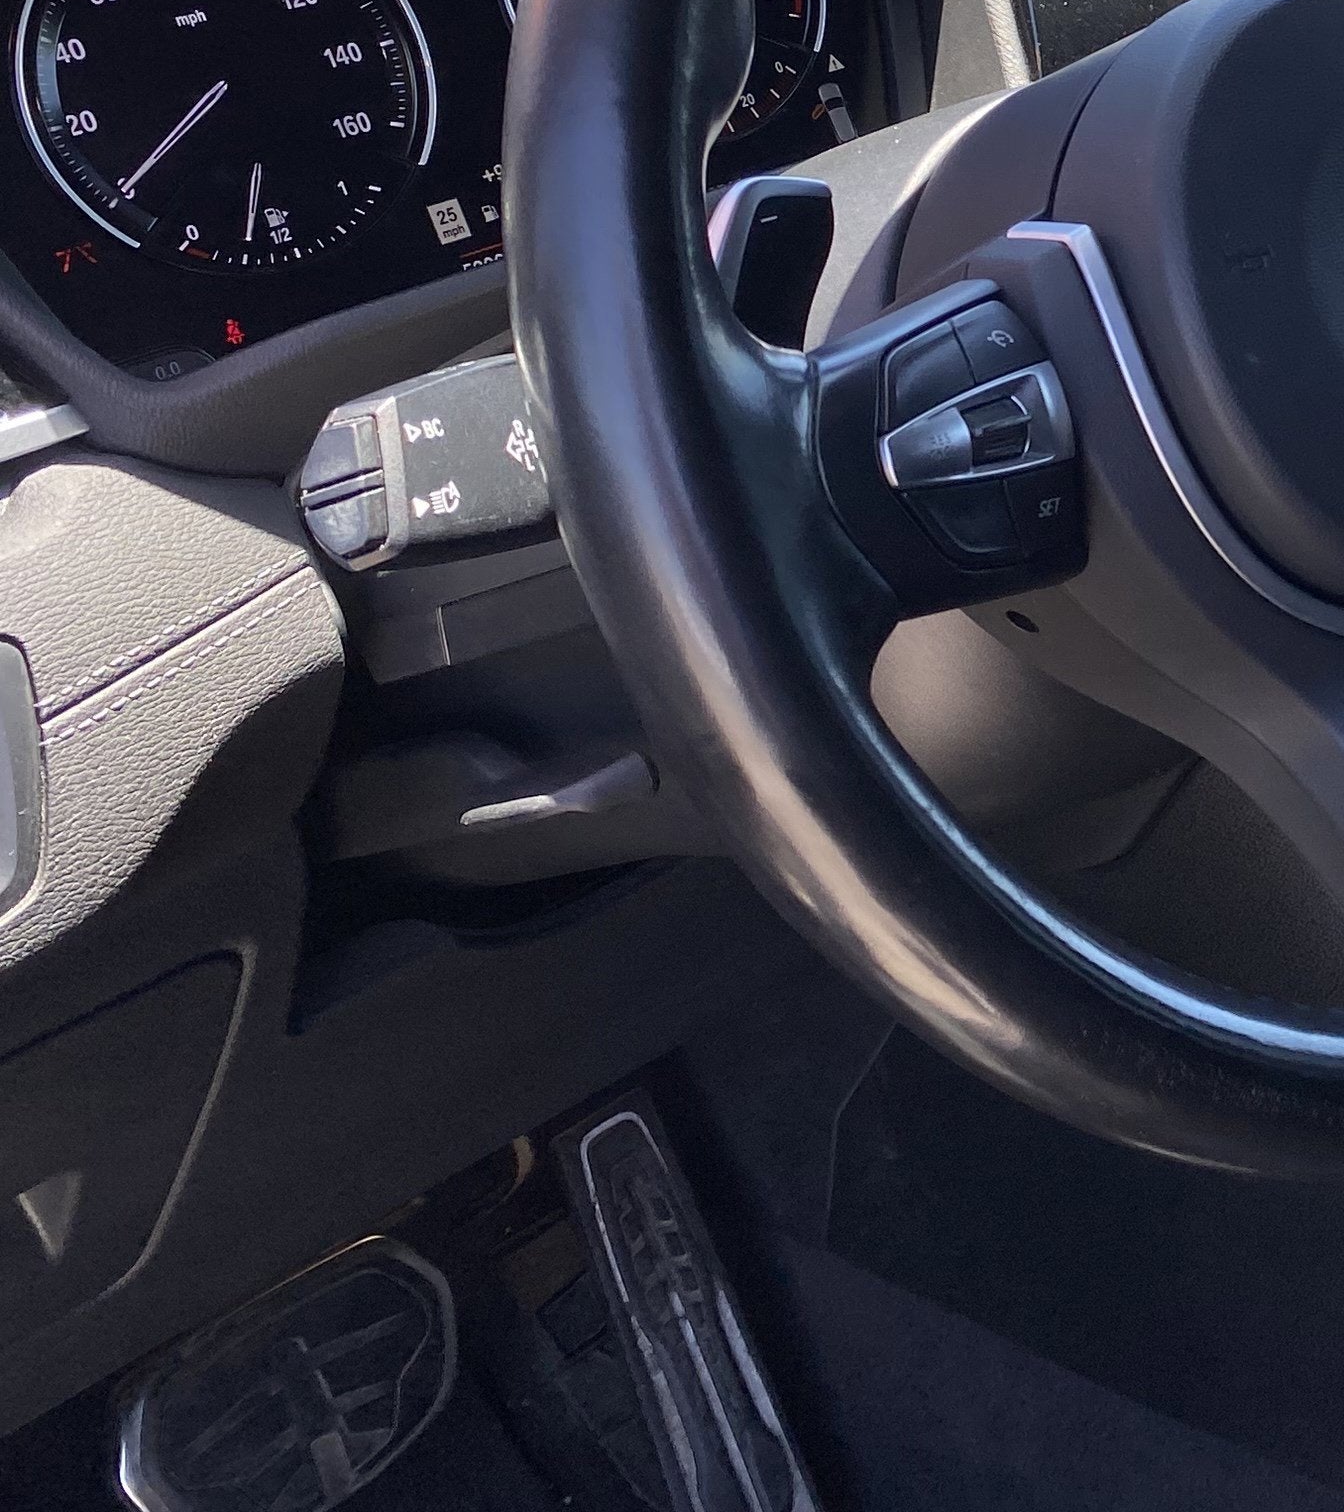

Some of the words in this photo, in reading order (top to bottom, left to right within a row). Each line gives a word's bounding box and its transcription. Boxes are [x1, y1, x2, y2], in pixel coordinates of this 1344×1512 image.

[174, 9, 208, 28] mph
[55, 37, 87, 64] 40
[322, 41, 364, 69] 140
[773, 60, 785, 74] 0
[739, 93, 756, 109] 20
[64, 109, 99, 137] 20
[332, 110, 373, 139] 160
[337, 180, 349, 197] 1
[436, 206, 458, 226] 25
[185, 224, 200, 241] 0
[270, 227, 293, 245] 1/2
[442, 224, 466, 239] mph
[154, 360, 182, 381] 0.0
[420, 417, 445, 439] BC
[1038, 497, 1062, 518] SET
